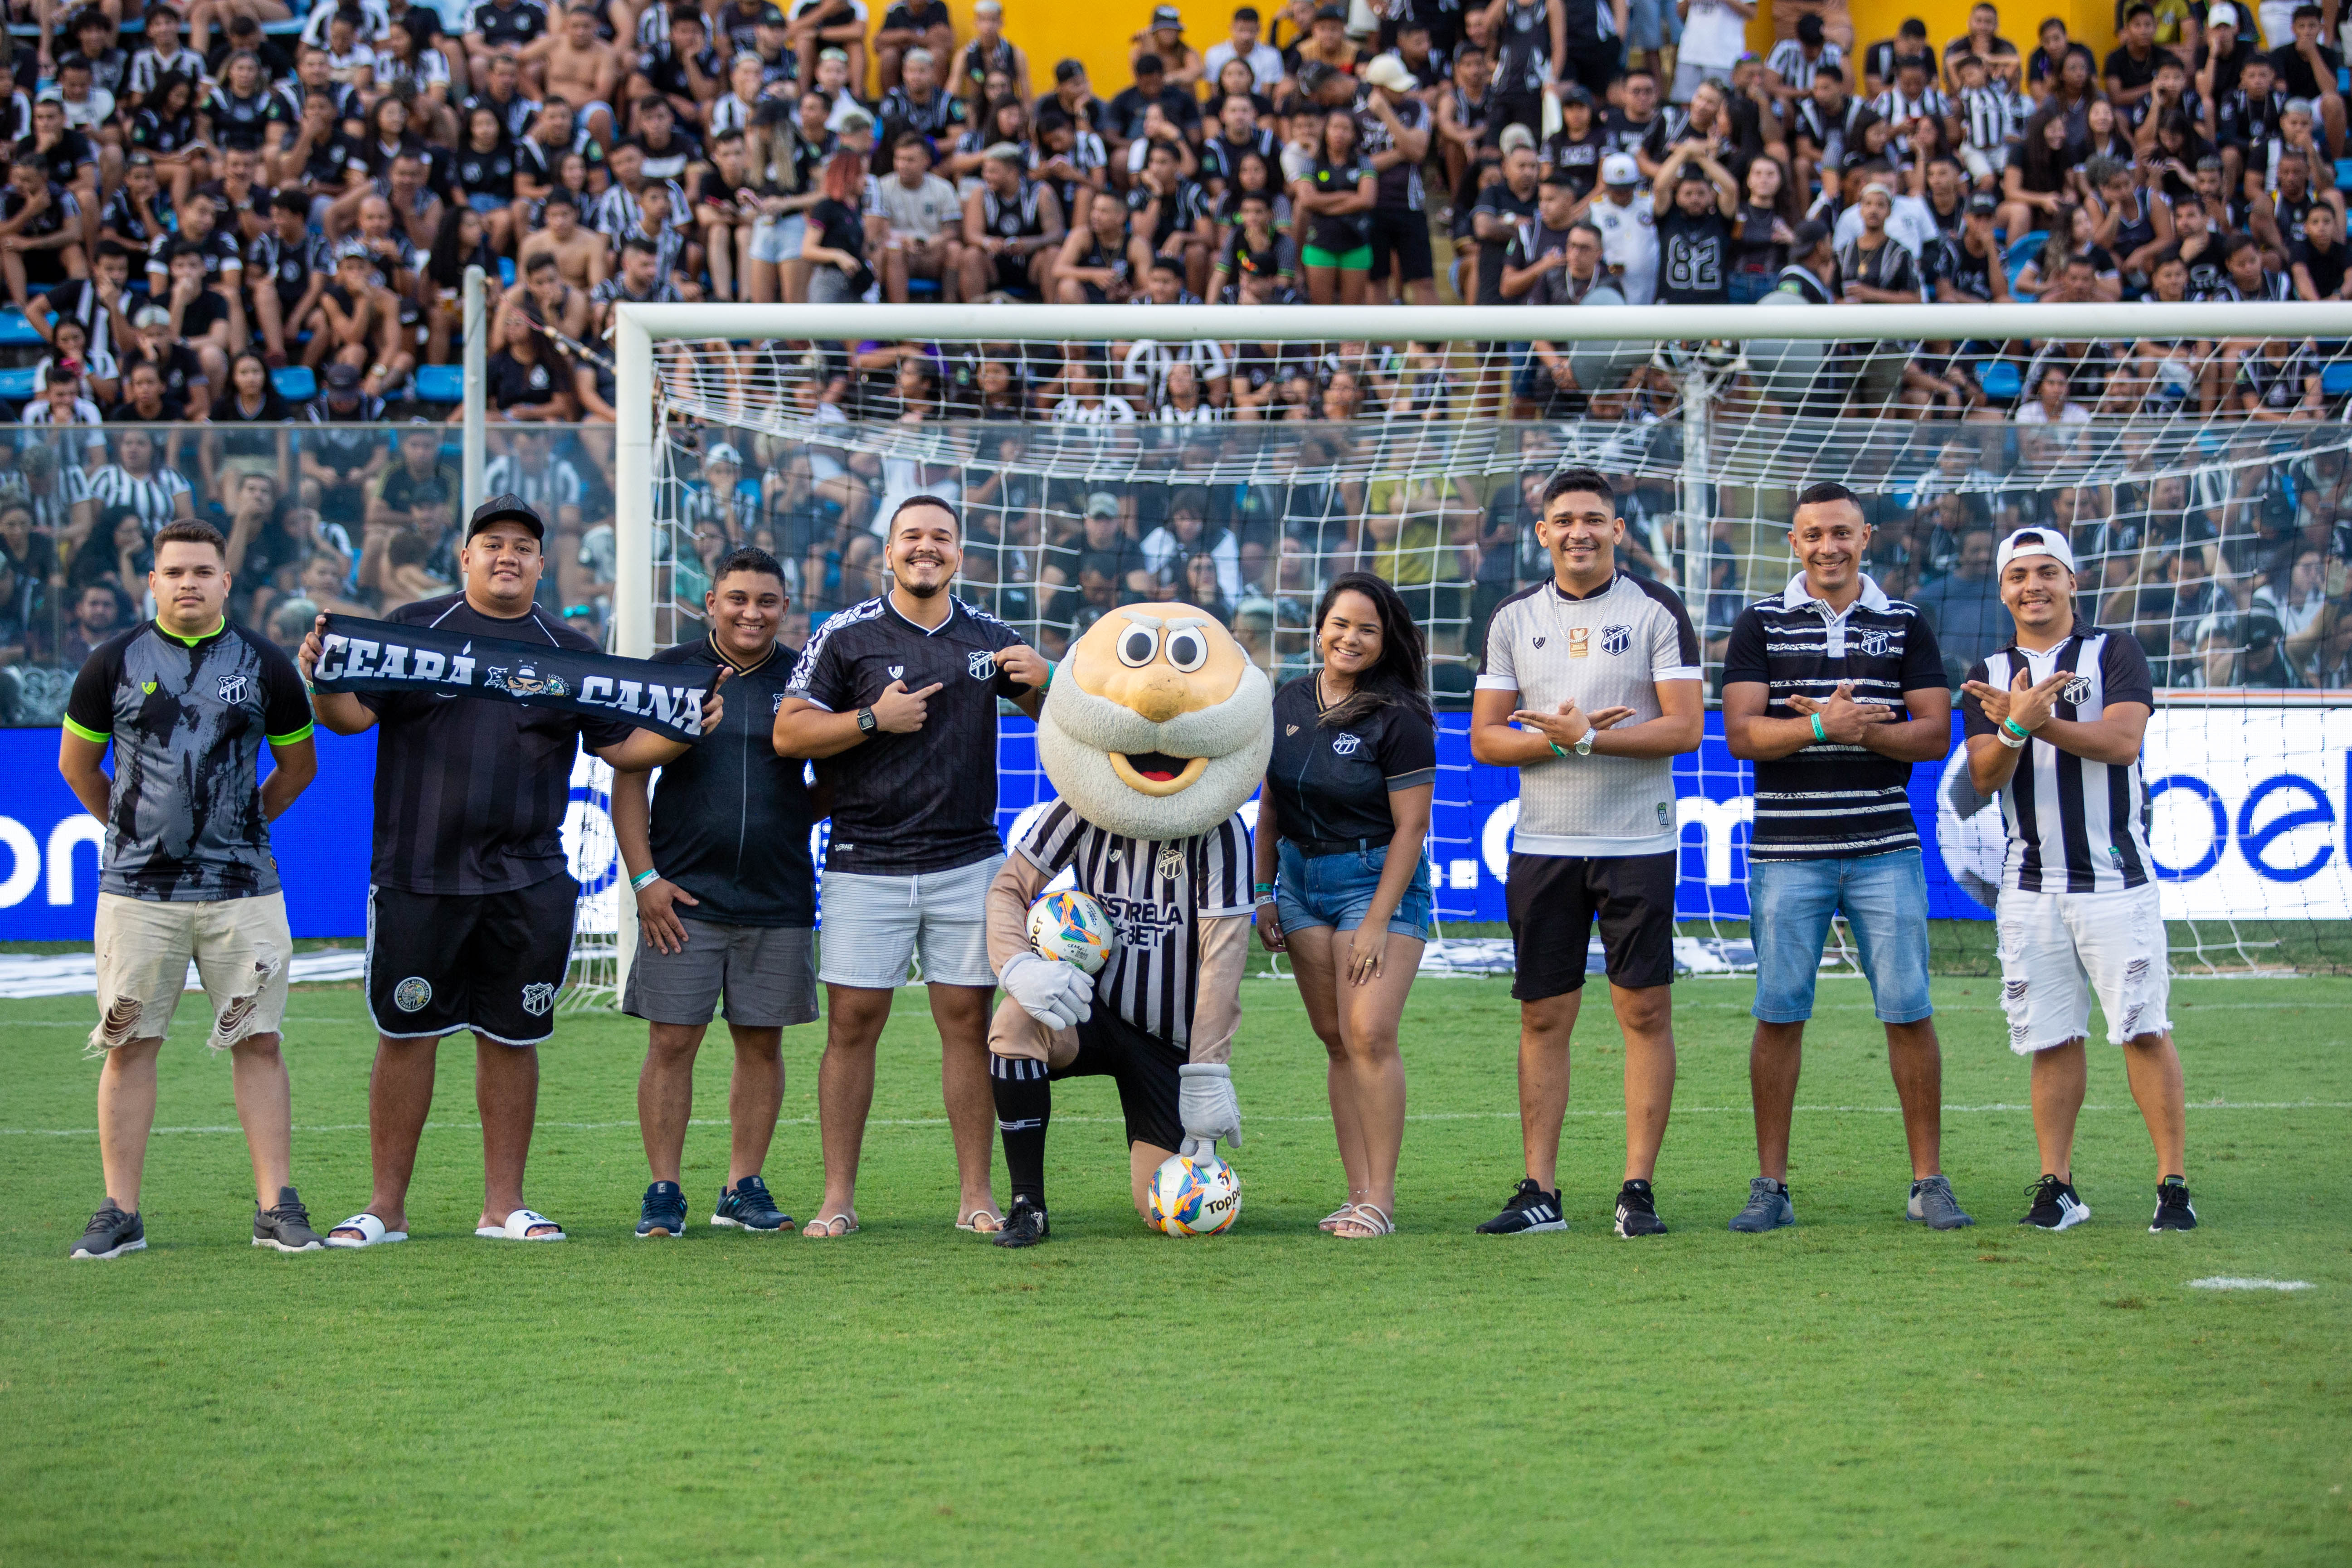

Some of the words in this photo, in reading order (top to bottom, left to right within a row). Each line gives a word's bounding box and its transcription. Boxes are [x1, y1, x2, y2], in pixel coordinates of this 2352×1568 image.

[1666, 234, 1722, 290] 82
[314, 633, 476, 685] CEARÁ
[576, 675, 707, 735] CANA
[1097, 894, 1184, 927] ESTRELA
[1127, 924, 1166, 947] BET
